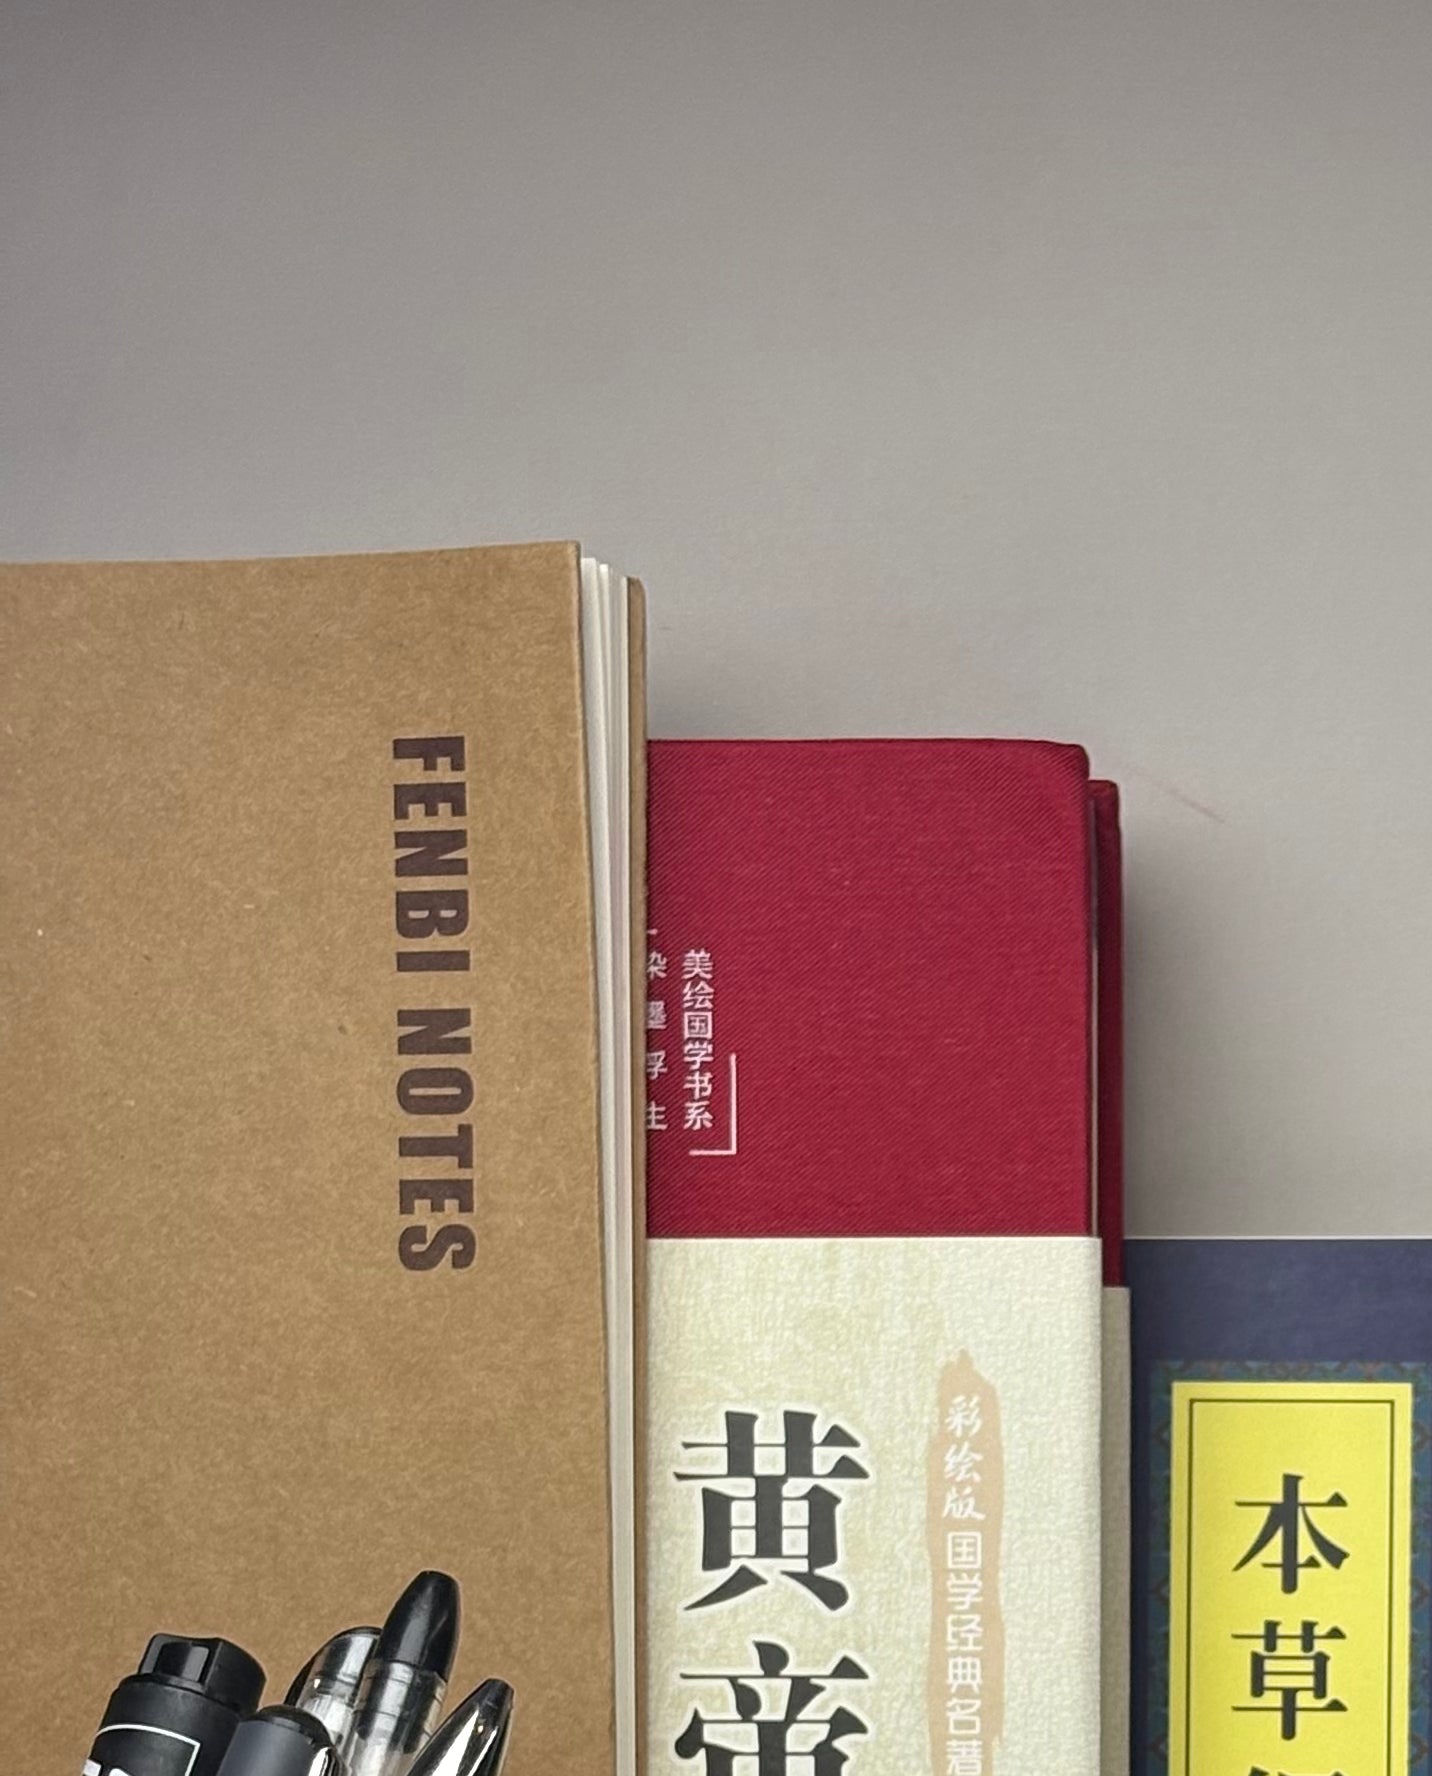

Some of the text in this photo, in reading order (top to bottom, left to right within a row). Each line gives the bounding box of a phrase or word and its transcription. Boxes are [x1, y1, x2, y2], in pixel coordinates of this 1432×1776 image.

[392, 735, 477, 1272] FENBI NOTES
[681, 948, 715, 1131] 美绘国学书系
